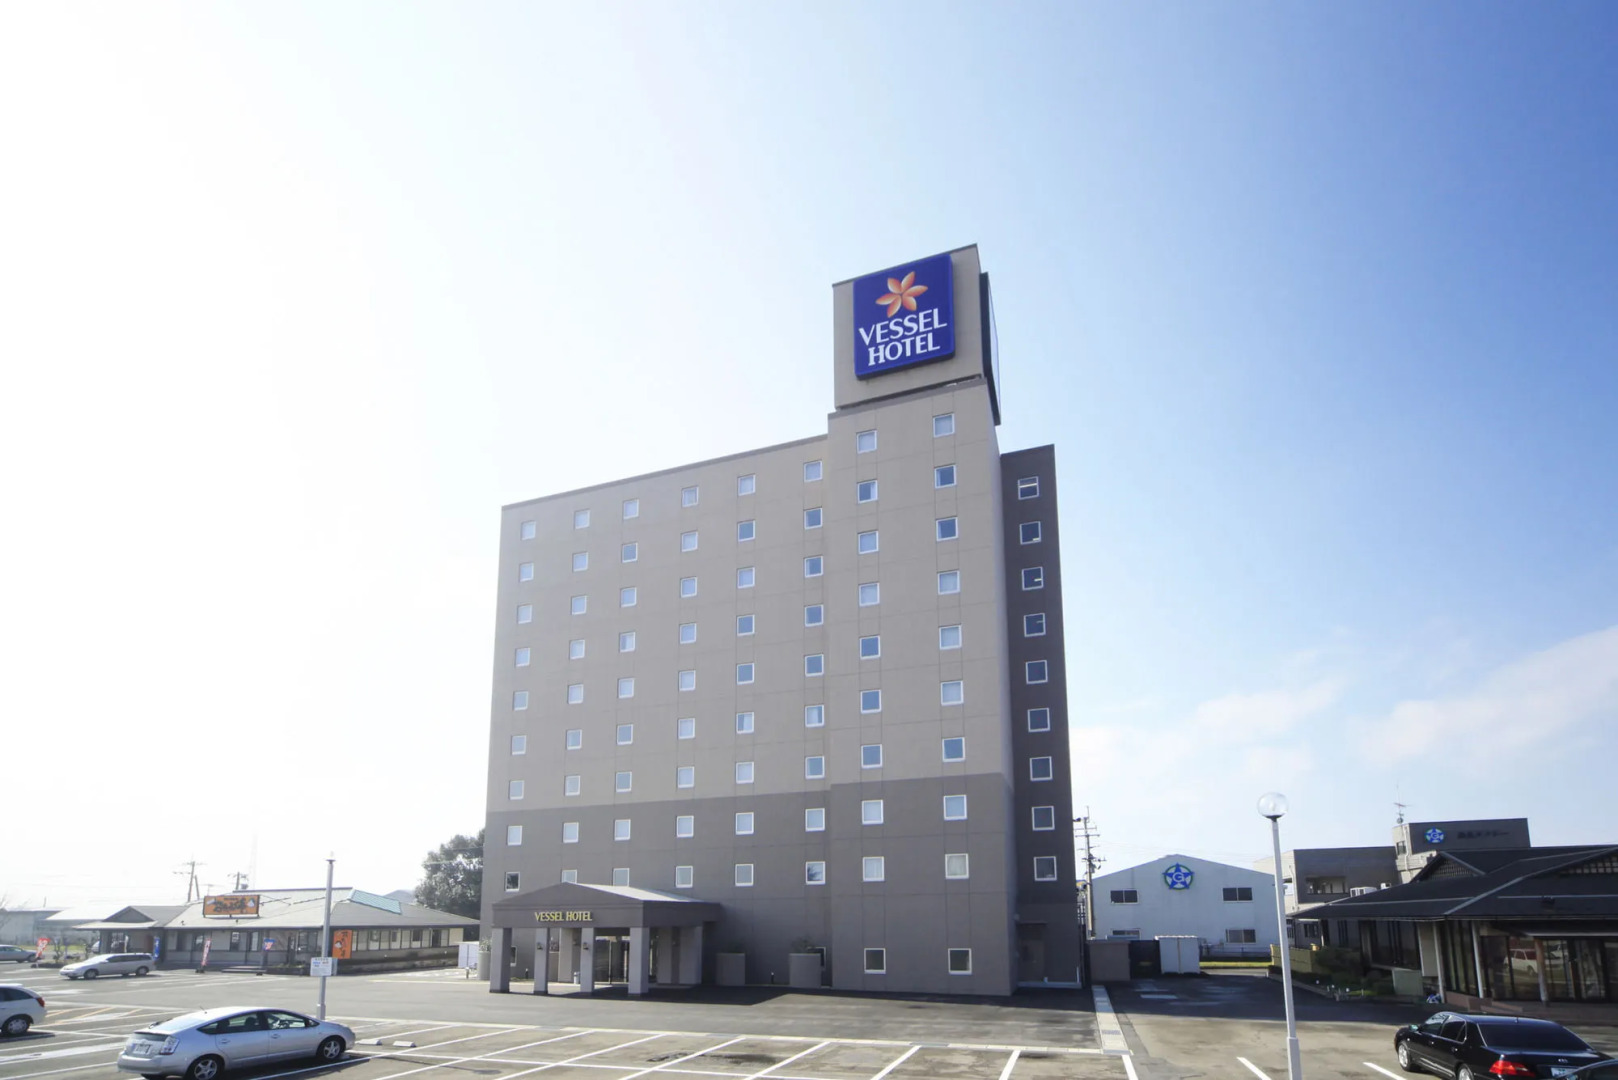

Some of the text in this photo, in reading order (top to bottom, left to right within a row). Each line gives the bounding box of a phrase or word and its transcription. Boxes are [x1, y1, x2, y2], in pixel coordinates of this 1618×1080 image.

[858, 307, 948, 346] VESSEL
[868, 332, 940, 366] HOTEL
[534, 910, 593, 922] VESSEL HOTEL
